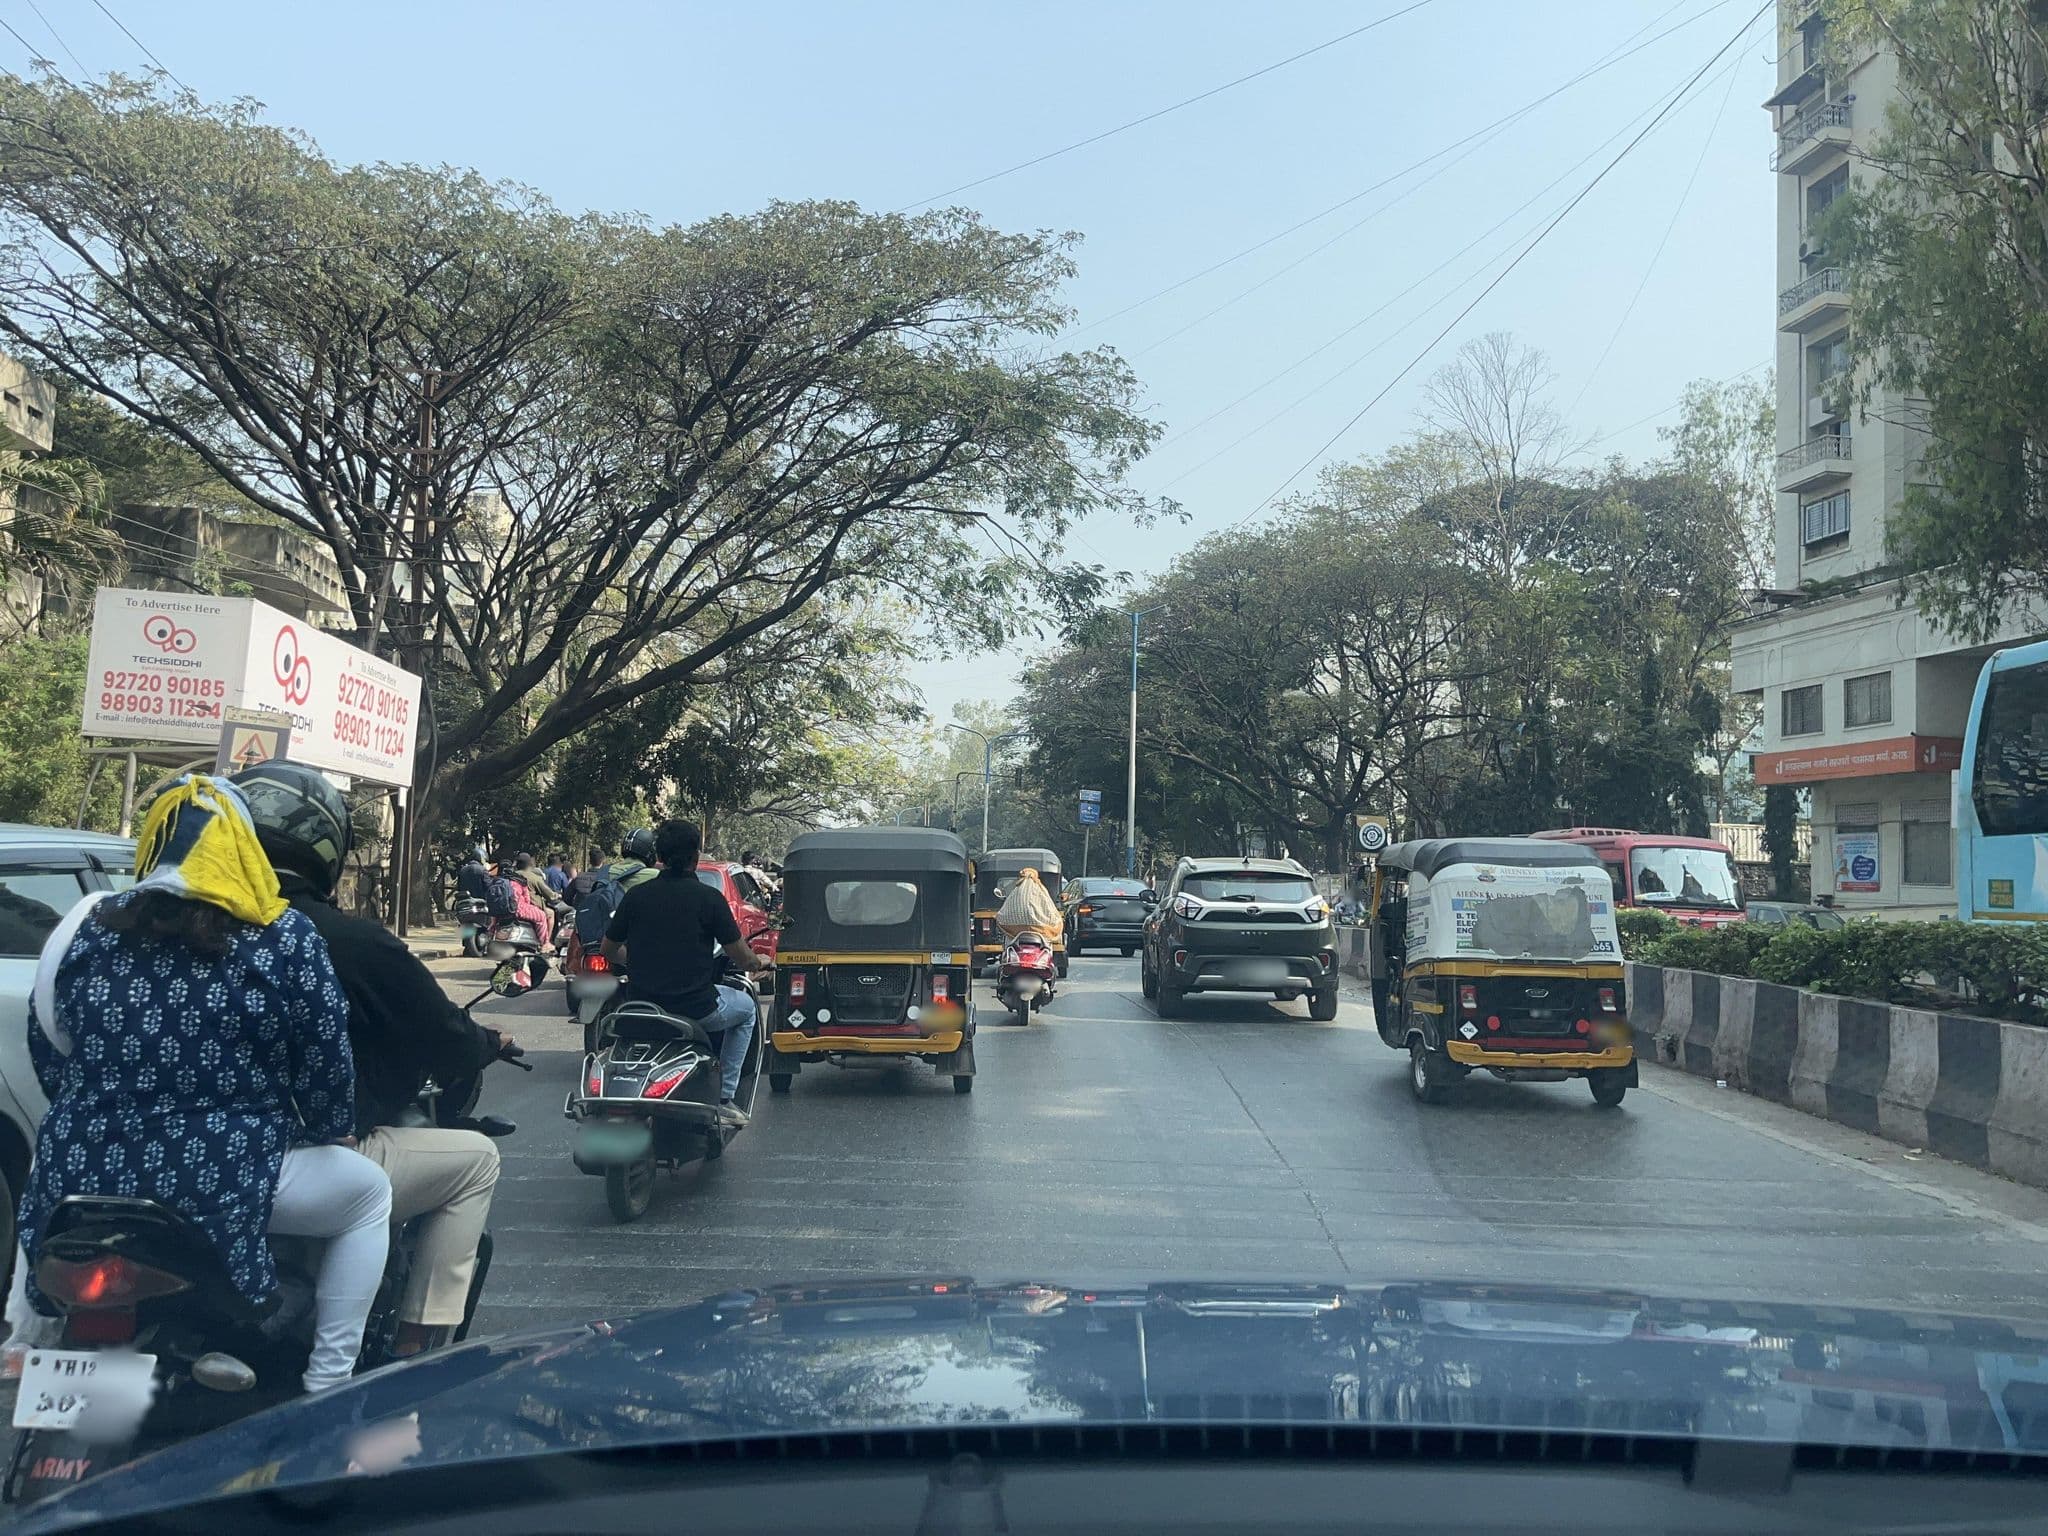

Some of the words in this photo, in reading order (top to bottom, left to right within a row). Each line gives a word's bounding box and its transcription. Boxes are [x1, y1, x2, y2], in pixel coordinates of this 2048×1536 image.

[125, 597, 138, 607] To
[140, 599, 192, 612] Advertise
[194, 604, 221, 615] Here
[132, 655, 202, 668] TECHSIDDHI
[103, 670, 162, 692] 92720
[167, 676, 225, 698] 90185
[101, 692, 163, 715] 98903
[338, 672, 375, 713] 92720
[377, 688, 409, 725] 90185
[95, 712, 120, 722] E-mail
[333, 710, 371, 748] 98903
[375, 724, 405, 758] 11234
[31, 1457, 92, 1482] ARMY
